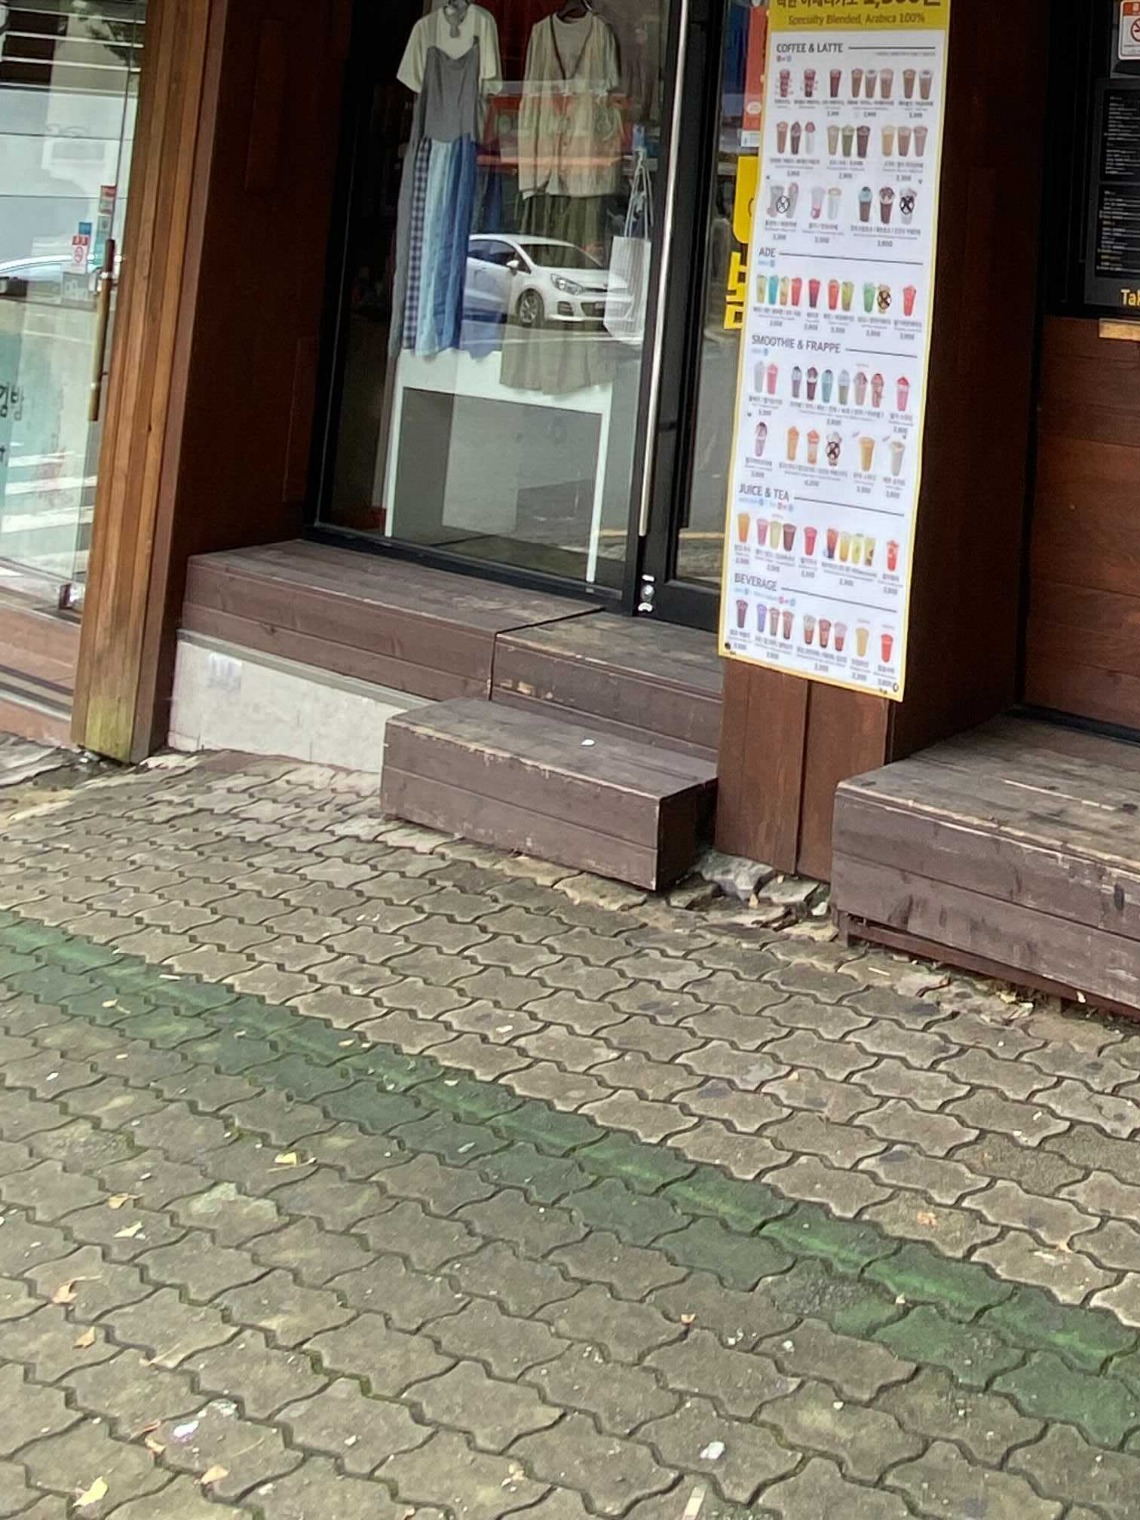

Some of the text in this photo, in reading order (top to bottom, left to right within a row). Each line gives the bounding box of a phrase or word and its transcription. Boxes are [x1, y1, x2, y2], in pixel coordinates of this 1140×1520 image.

[776, 43, 844, 53] COFFEE & LATTE
[758, 247, 776, 258] ADE
[751, 334, 841, 354] SMOOTHIE & FRAPPE
[739, 484, 789, 501] JUICE & TEA
[734, 572, 778, 592] BEVERAGE
